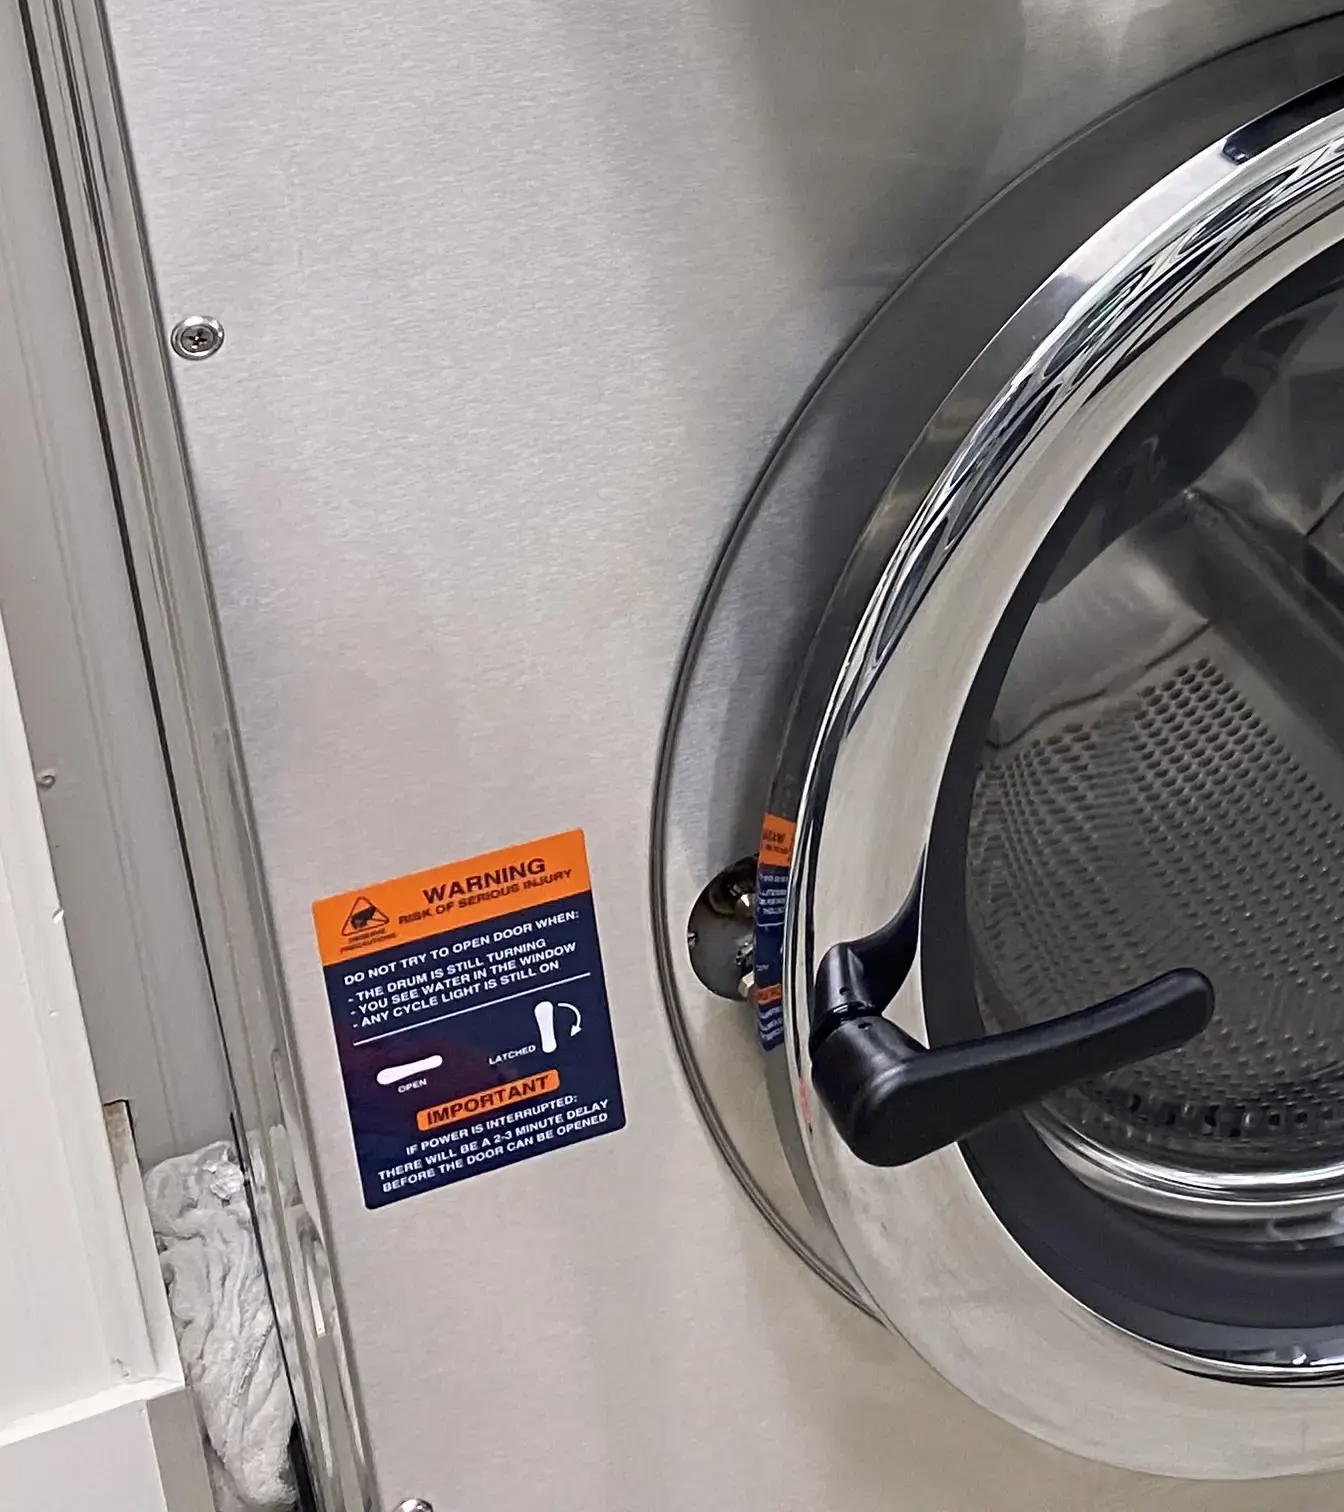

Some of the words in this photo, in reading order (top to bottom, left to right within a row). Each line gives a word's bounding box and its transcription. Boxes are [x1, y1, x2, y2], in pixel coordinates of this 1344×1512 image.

[422, 857, 546, 905] WARNING
[343, 971, 365, 986] DO
[367, 961, 397, 979] NOT
[399, 953, 427, 969] TRY
[429, 946, 450, 960] TO
[452, 934, 491, 954] OPEN
[493, 922, 533, 942] DOOR
[535, 910, 579, 929] WHEN:
[355, 985, 385, 1002] THE
[386, 972, 428, 993] DRUM
[430, 968, 444, 980] IS
[446, 957, 484, 975] STILL
[485, 938, 547, 963] TURNING
[358, 997, 388, 1014] YOU
[391, 988, 419, 1005] SEE
[420, 973, 471, 996] WATER
[473, 967, 488, 981] IN
[489, 959, 517, 975] THE
[519, 941, 576, 966] WINDOW
[361, 1010, 389, 1027] ANY
[392, 995, 439, 1017] CYCLE
[441, 982, 481, 1003] LIGHT
[483, 978, 498, 990] IS
[499, 967, 537, 985] STILL
[539, 959, 559, 974] ON
[488, 1044, 537, 1065] LATCHED
[405, 1143, 418, 1156] IF
[420, 1128, 469, 1151] POWER
[470, 1123, 484, 1135] IS
[485, 1095, 578, 1130] INTERRUPTED:
[426, 1074, 549, 1126] IMPORTANT
[377, 1158, 423, 1181] THERE
[424, 1148, 458, 1165] WILL
[460, 1140, 478, 1154] BE
[481, 1137, 492, 1148] A
[515, 1113, 564, 1137] MINUTE
[566, 1098, 609, 1120] DELAY
[382, 1167, 436, 1193] BEFORE
[437, 1158, 464, 1174] THE
[466, 1146, 504, 1165] DOOR
[506, 1136, 534, 1152] CAN
[536, 1130, 554, 1143] BE
[556, 1112, 608, 1136] OPENED
